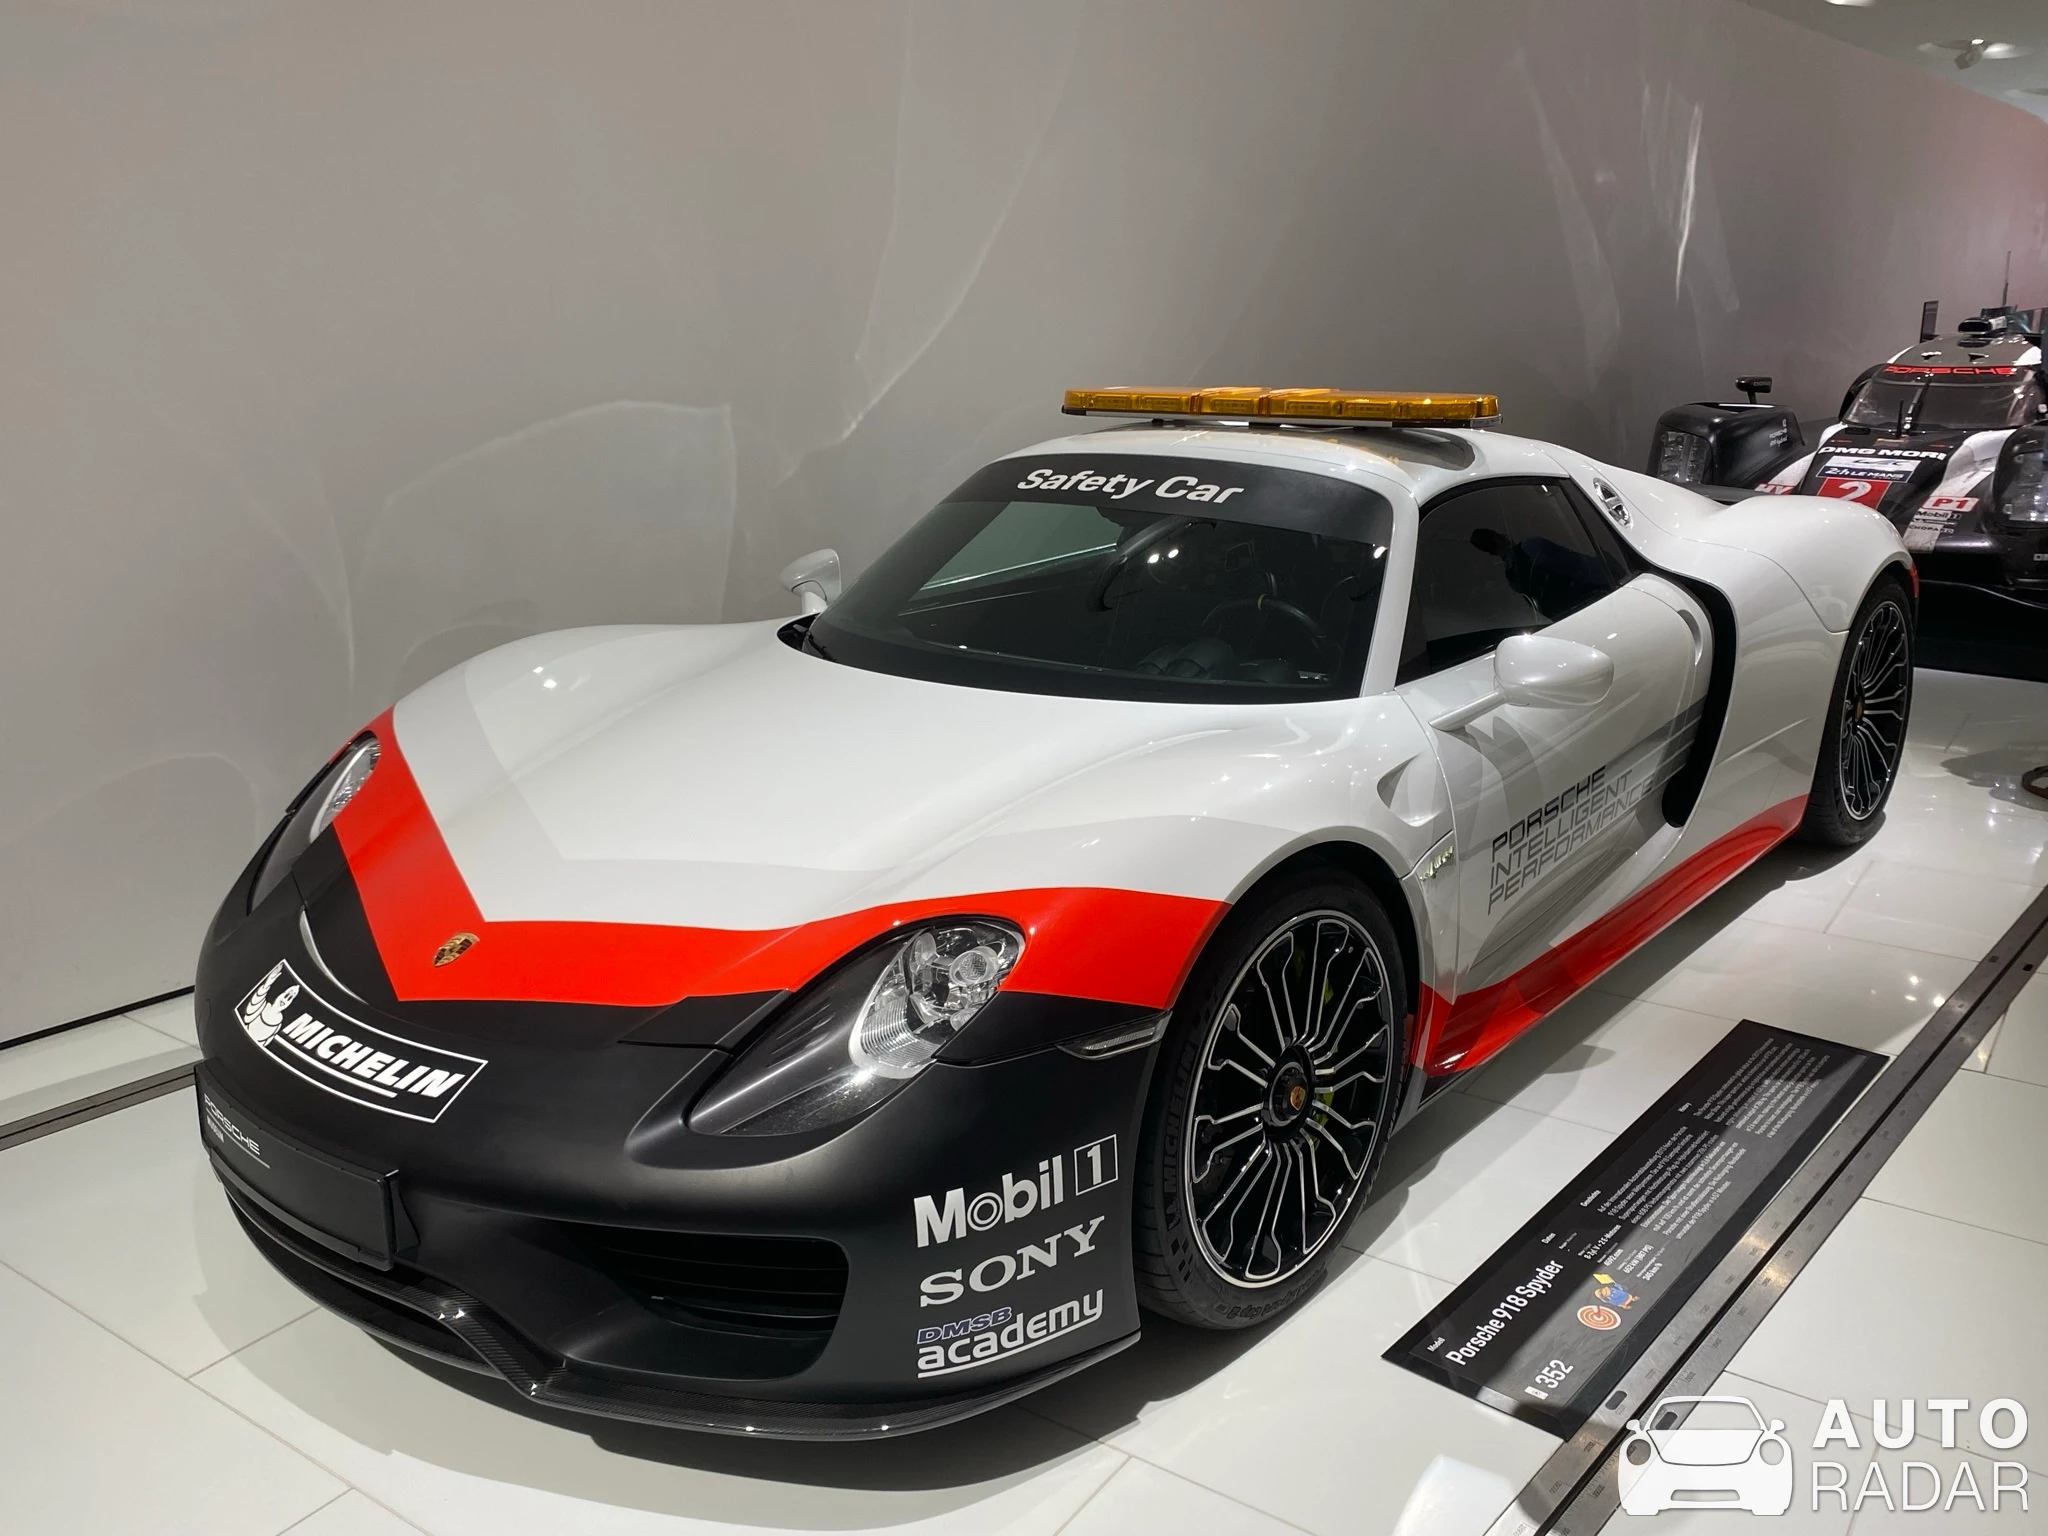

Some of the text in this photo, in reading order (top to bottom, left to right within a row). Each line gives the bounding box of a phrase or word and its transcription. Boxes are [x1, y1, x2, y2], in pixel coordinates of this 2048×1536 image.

[1883, 364, 2017, 376] PORSCHE
[1819, 446, 1947, 461] DMG MORI
[1017, 469, 1245, 504] Safety Car
[1839, 480, 1872, 501] 2
[1917, 510, 1949, 518] Mobil
[1931, 498, 1967, 509] P1
[1487, 772, 1655, 916] PERFORMANCE
[1490, 769, 1632, 889] INTELLIGENT
[1492, 765, 1606, 862] PORSCHE
[282, 1012, 465, 1099] MICHELIN
[204, 1093, 261, 1156] PORSCHE
[1163, 1042, 1197, 1193] MICHELIN
[913, 1144, 1102, 1248] Mobil 1
[920, 1215, 1105, 1308] SONY
[916, 1306, 1013, 1344] DMSB
[917, 1288, 1104, 1371] academy
[1427, 1337, 1445, 1351] Modell
[1446, 1260, 1563, 1365] Porsche 918 Spyder
[1535, 1360, 1573, 1388] 352
